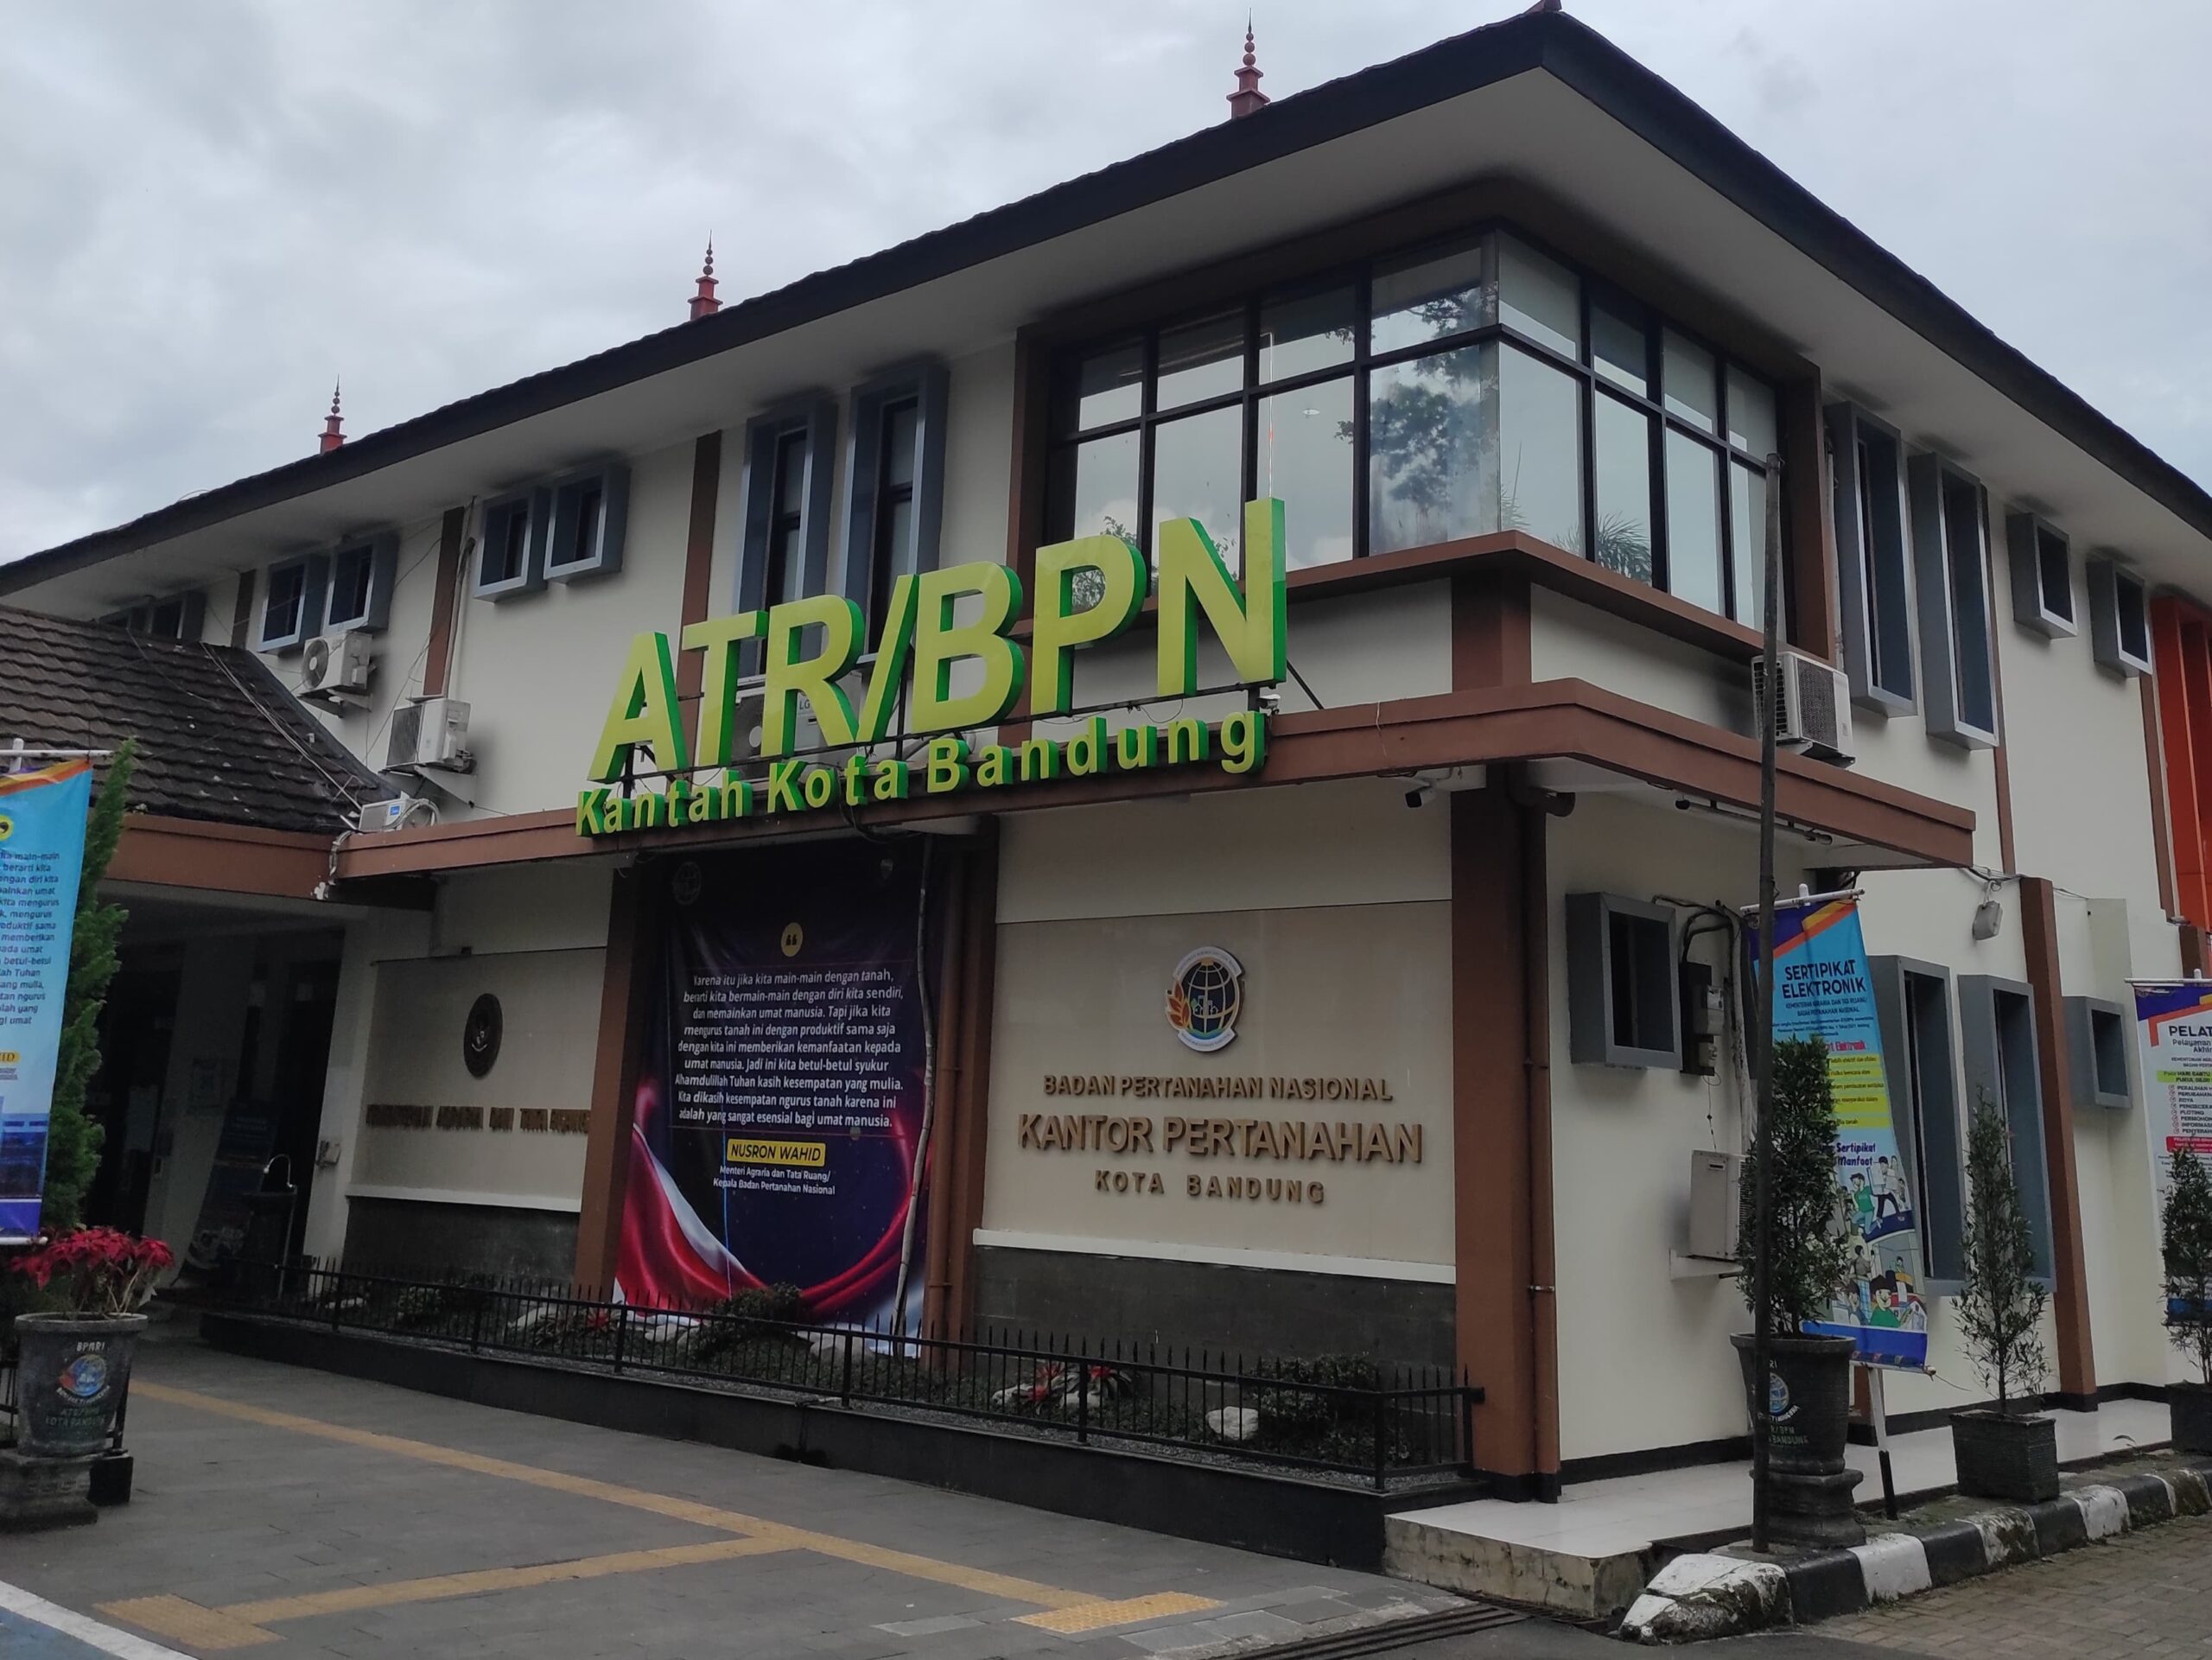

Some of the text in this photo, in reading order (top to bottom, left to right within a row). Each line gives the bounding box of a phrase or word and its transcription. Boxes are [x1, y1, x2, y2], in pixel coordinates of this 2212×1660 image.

[587, 497, 1286, 784] ATR/BPN
[575, 710, 1265, 838] Kantah Kota Bandung
[0, 875, 26, 884] ngan
[18, 899, 60, 908] mengurus
[10, 911, 53, 919] mengurus
[0, 921, 33, 930] oduktif
[2, 933, 55, 942] memberikan
[1784, 959, 1856, 981] SERTIPIKAT
[723, 974, 735, 985] itu
[736, 973, 753, 989] jika
[755, 973, 772, 984] kita
[774, 971, 823, 984] main-main
[824, 970, 859, 985] dengan
[1782, 977, 1866, 999] ELEKTRONIK
[709, 990, 727, 1002] kita
[728, 989, 791, 1002] bermain-main
[792, 989, 826, 1003] dengan
[828, 988, 844, 1000] diri
[846, 988, 864, 1000] kita
[866, 986, 904, 1000] sendiri,
[18, 1005, 39, 1014] yang
[693, 1008, 706, 1020] dan
[760, 1008, 782, 1019] umat
[785, 1006, 825, 1019] manusia.
[829, 1005, 848, 1021] Tapi
[848, 1005, 868, 1021] jika
[871, 1004, 891, 1017] kita
[684, 1022, 896, 1039] mengurus tanah ini dengan produktif sama saja
[2169, 1026, 2212, 1037] PELAT
[677, 1040, 901, 1056] dengan kita ini memberikan kemanfaatan kepada
[2172, 1039, 2211, 1047] Pelayanan
[684, 1059, 889, 1074] umat manusia. Jadi ini kita betul-betul syukur
[729, 1074, 756, 1088] Tuhan
[757, 1075, 782, 1089] kasih
[783, 1075, 842, 1091] kesempatan
[844, 1078, 868, 1092] yang
[869, 1077, 904, 1090] mulia.
[1044, 1075, 1393, 1101] BADAN PERTANAHAN NASIONAL
[693, 1091, 724, 1103] dikasih
[726, 1092, 777, 1108] kesempatan
[779, 1095, 811, 1110] ngurus
[813, 1094, 842, 1107] tanah
[844, 1095, 880, 1108] karena
[882, 1095, 897, 1109] ini
[706, 1110, 726, 1124] yang
[728, 1111, 755, 1125] sangat
[757, 1111, 793, 1124] esensial
[795, 1110, 815, 1128] bagi
[817, 1114, 843, 1126] umat
[844, 1114, 893, 1128] manusia.
[1018, 1112, 1423, 1164] KANTOR PERTANAHAN
[730, 1143, 822, 1161] NUSRON WAHID
[1836, 1142, 1876, 1154] Sertipikat
[1838, 1155, 1873, 1167] Manfaat
[719, 1165, 746, 1176] Menteri
[746, 1167, 770, 1179] Agraria
[771, 1168, 785, 1179] dan
[785, 1169, 802, 1180] Tata
[713, 1177, 836, 1195] Kepala Badan Pertanahan Nasional
[1094, 1170, 1325, 1204] KOTA BANDUNG
